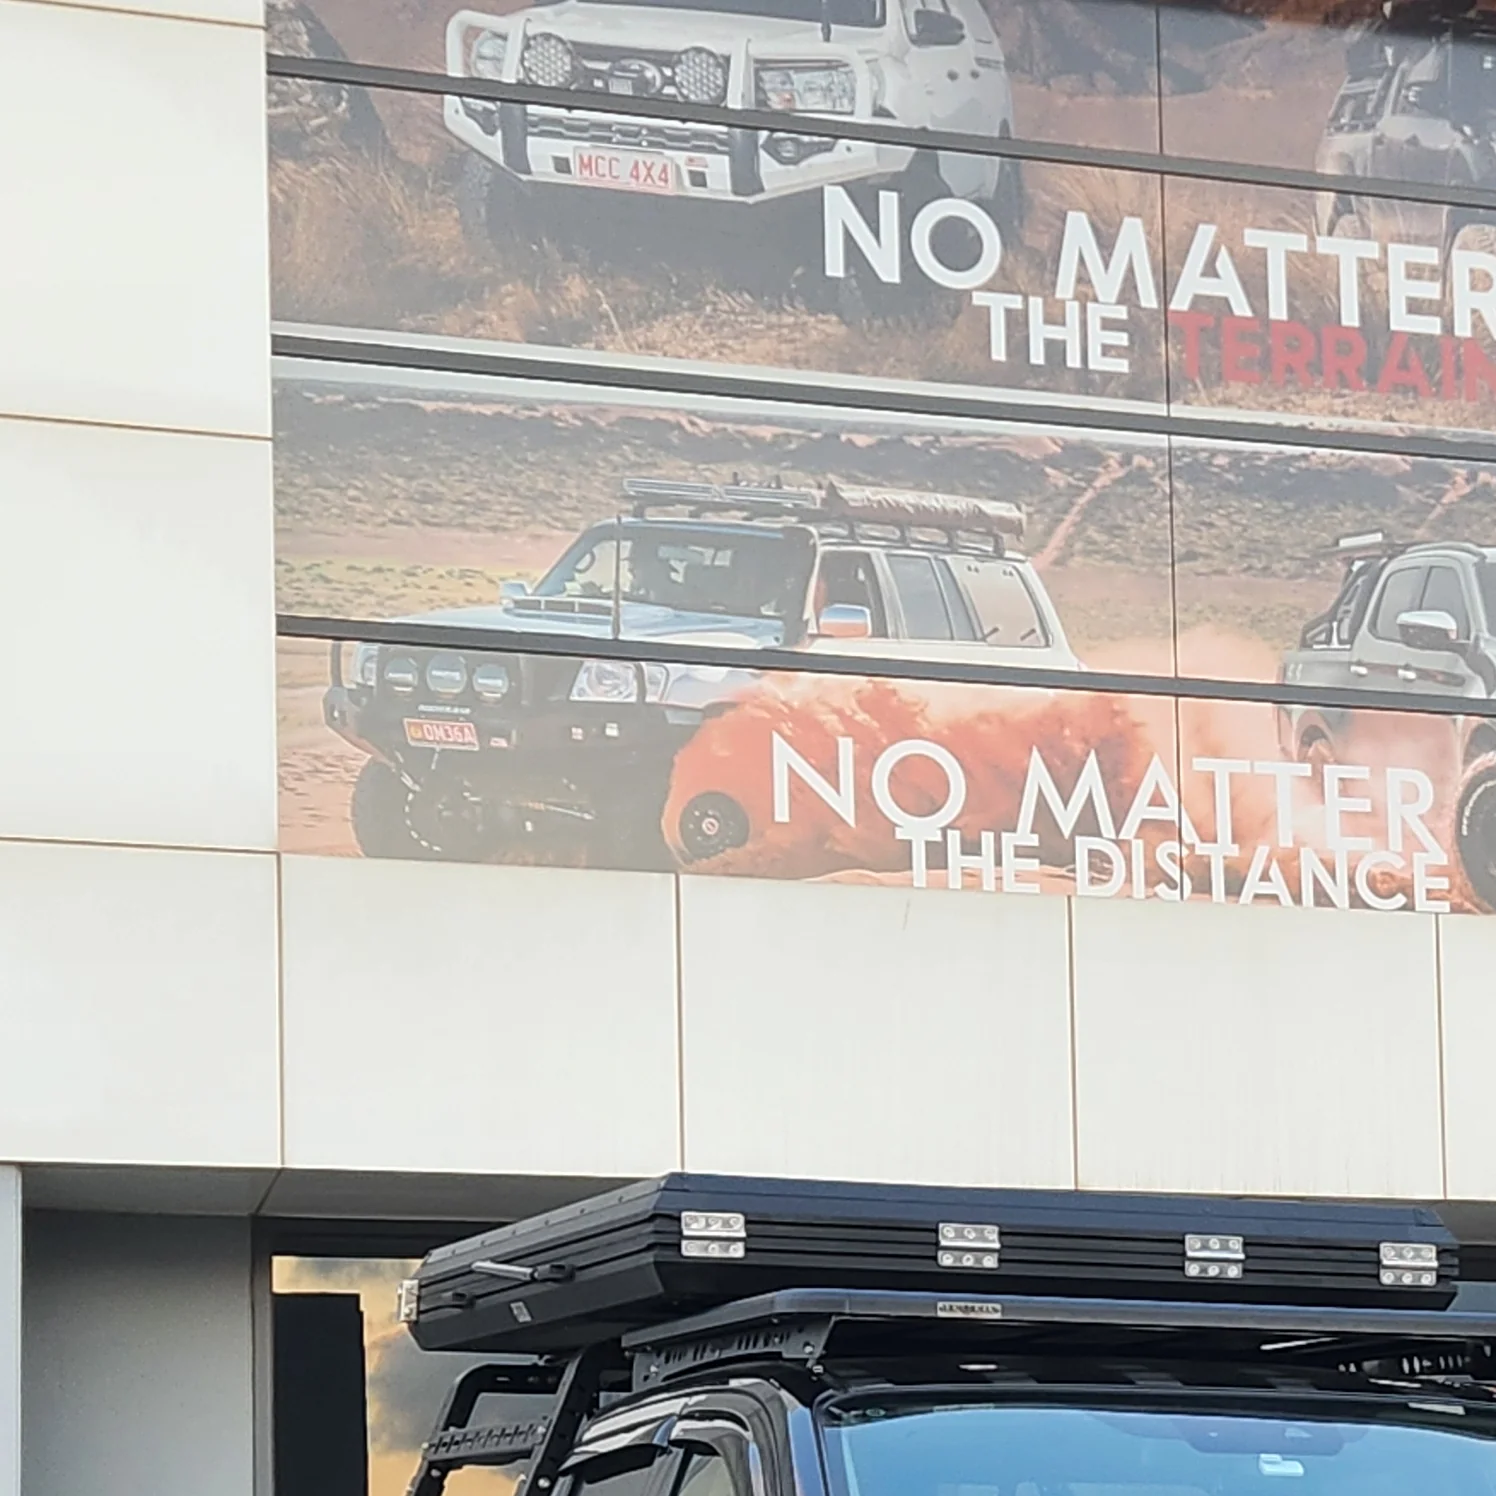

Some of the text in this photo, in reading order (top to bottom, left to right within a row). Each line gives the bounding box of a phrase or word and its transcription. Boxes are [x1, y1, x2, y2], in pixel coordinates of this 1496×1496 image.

[577, 153, 621, 180] MCC
[629, 159, 670, 186] 4X4
[823, 185, 1002, 291] NO
[972, 291, 1130, 374] THE
[772, 733, 967, 831] NO
[1017, 744, 1447, 863] MATTER
[895, 828, 1042, 894] THE
[1075, 836, 1451, 914] DISTANCE
